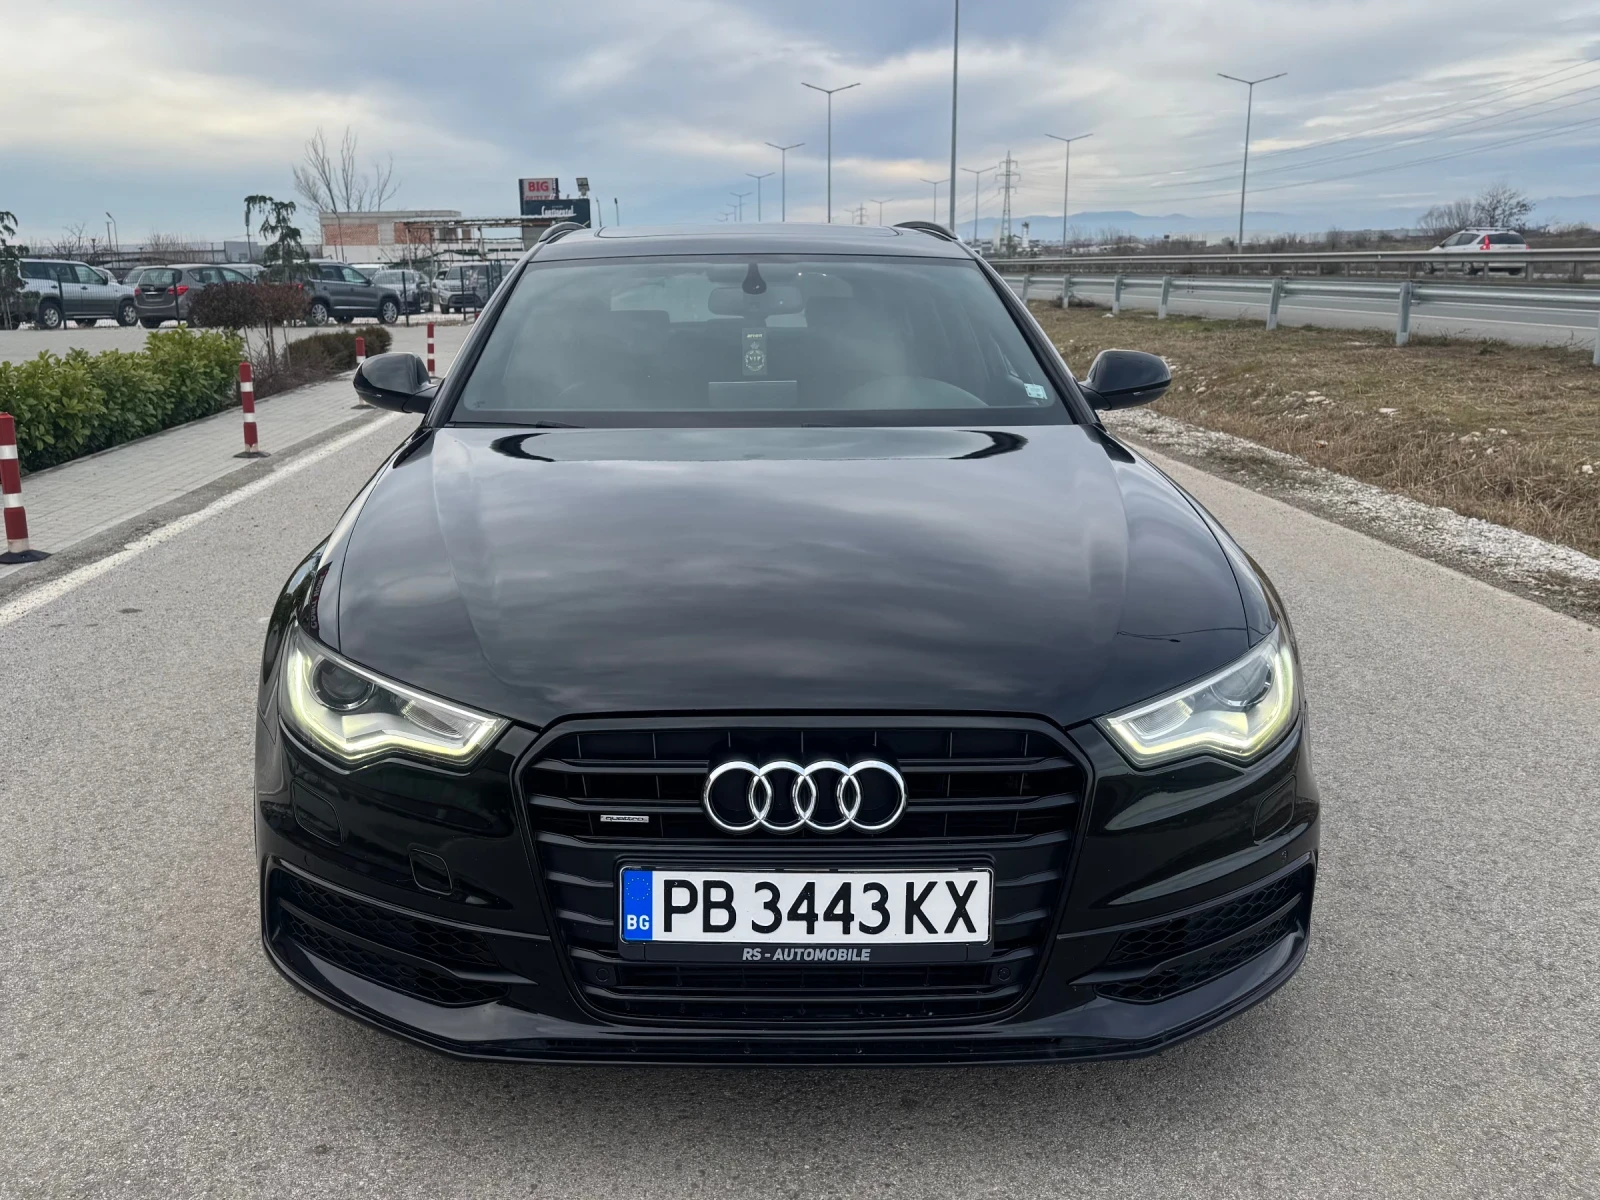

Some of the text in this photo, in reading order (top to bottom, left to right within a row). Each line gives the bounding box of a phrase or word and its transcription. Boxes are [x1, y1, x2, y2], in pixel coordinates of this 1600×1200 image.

[528, 181, 549, 192] BIG
[663, 879, 978, 935] PB 3443 KX
[626, 914, 650, 930] BG
[742, 948, 762, 961] RS
[773, 948, 871, 961] AUTOMOBILE
